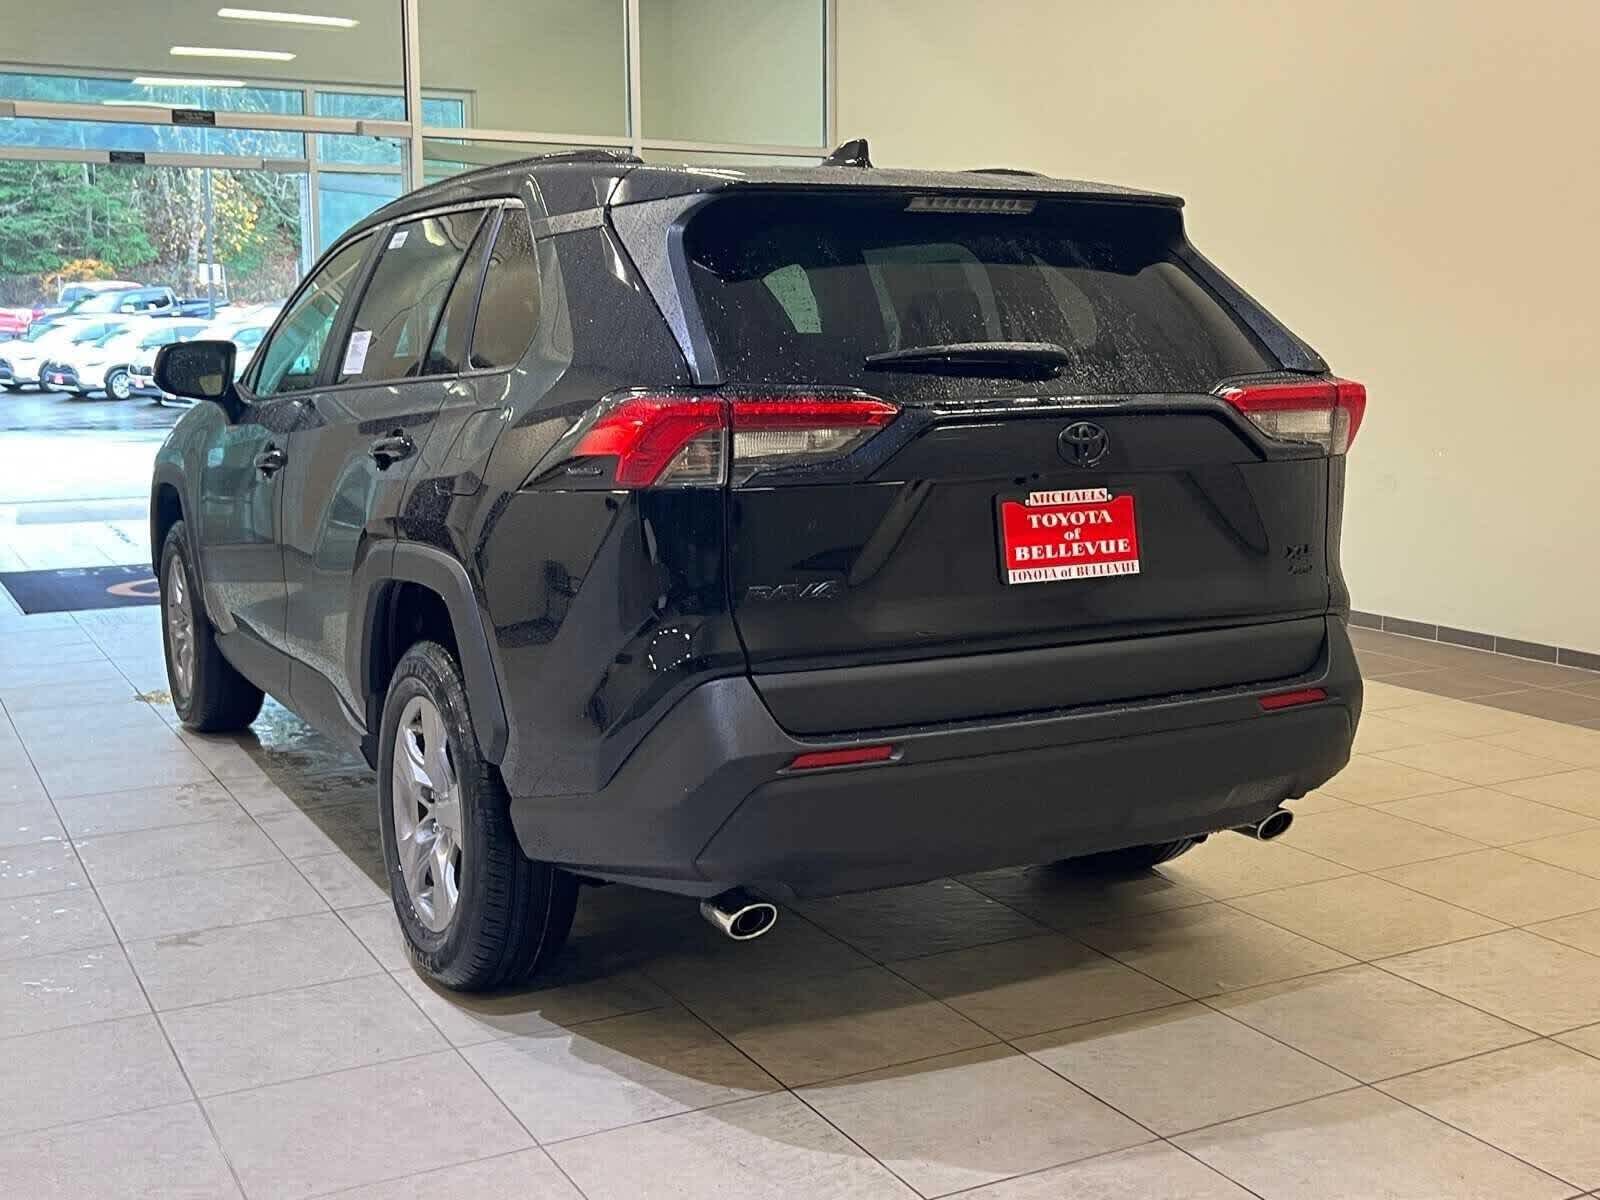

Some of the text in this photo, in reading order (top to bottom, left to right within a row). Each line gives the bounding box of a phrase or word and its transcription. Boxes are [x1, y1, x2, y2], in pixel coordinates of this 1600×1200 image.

[1031, 490, 1106, 505] MICHAELS
[1027, 510, 1113, 529] TOYOTA
[1064, 528, 1082, 541] of
[1014, 538, 1131, 561] BELLEVUE
[1011, 561, 1138, 583] TOYOTA of BELLEVUE
